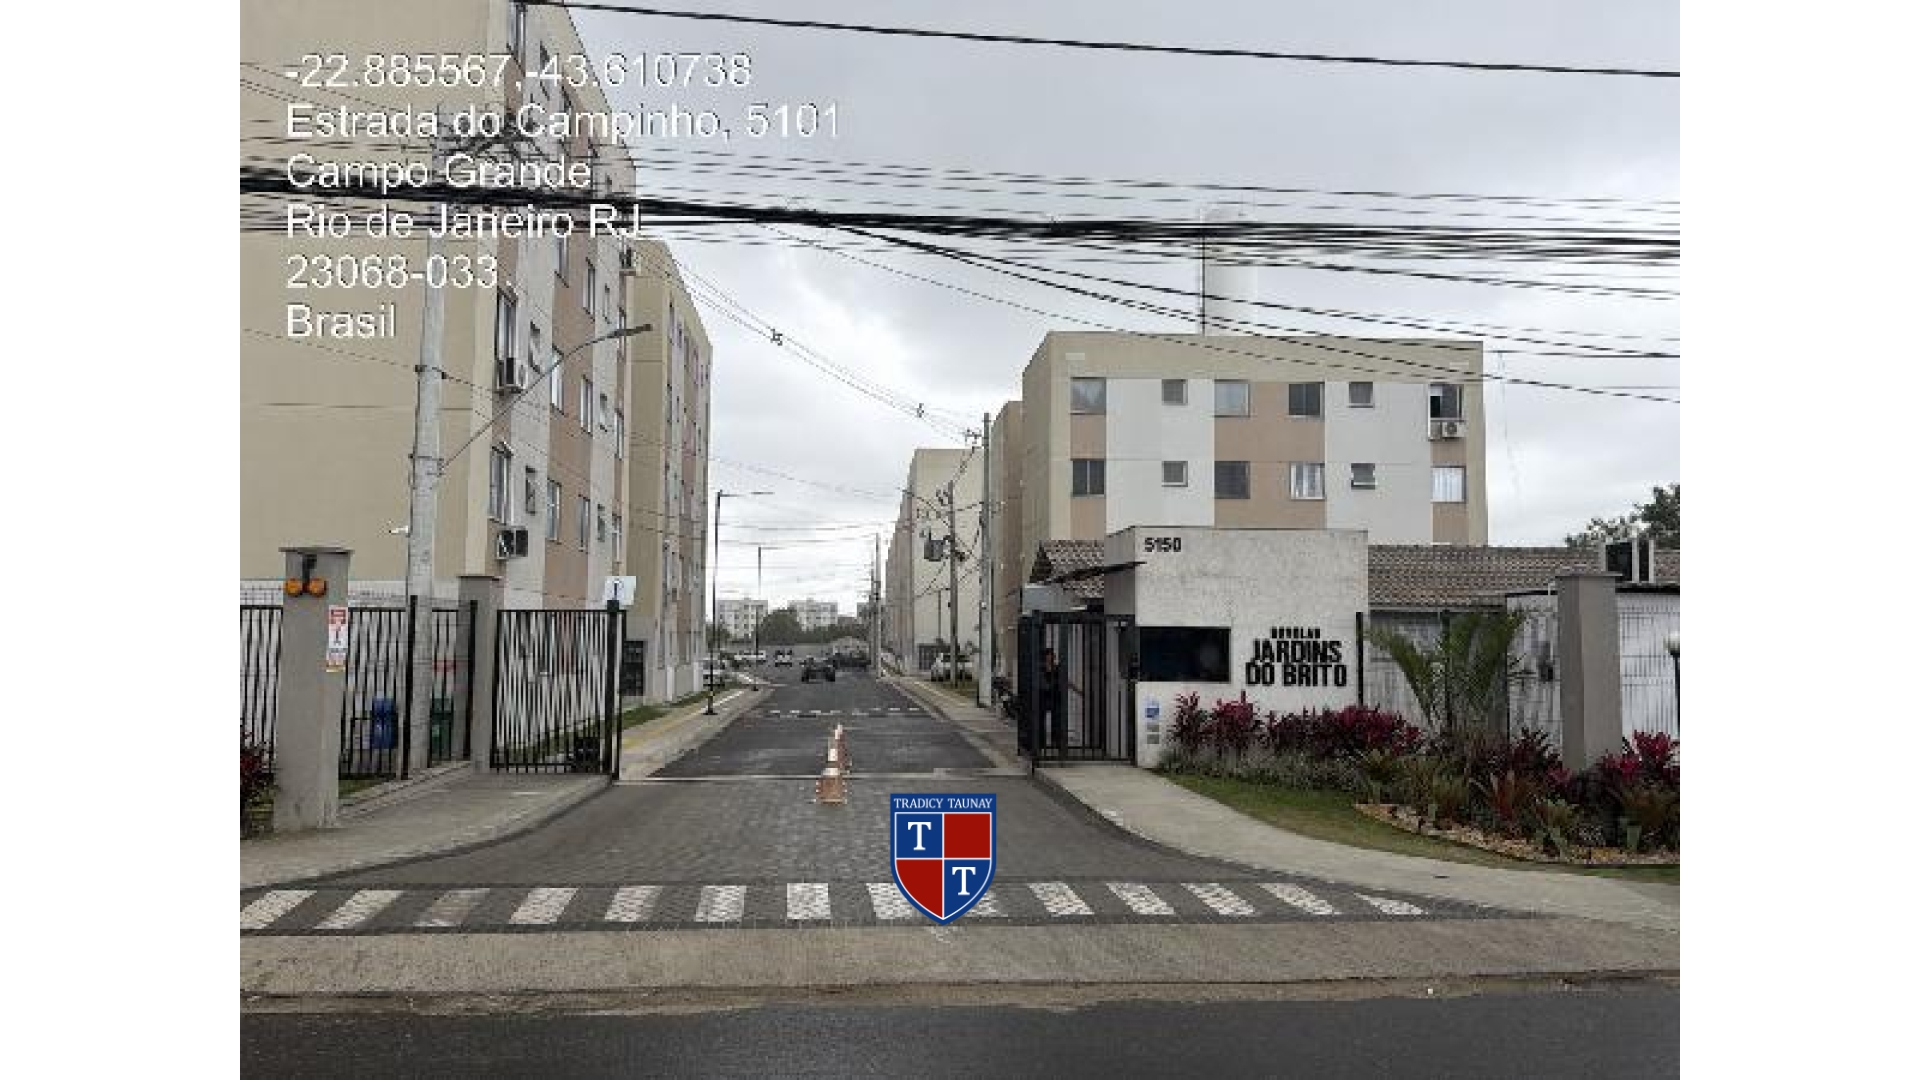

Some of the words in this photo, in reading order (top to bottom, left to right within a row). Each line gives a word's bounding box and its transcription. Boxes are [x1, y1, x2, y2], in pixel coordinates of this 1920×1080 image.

[1144, 537, 1182, 552] 5150
[1251, 639, 1343, 663] JARDINS
[1245, 663, 1275, 686] DO
[1283, 663, 1348, 687] BRITO
